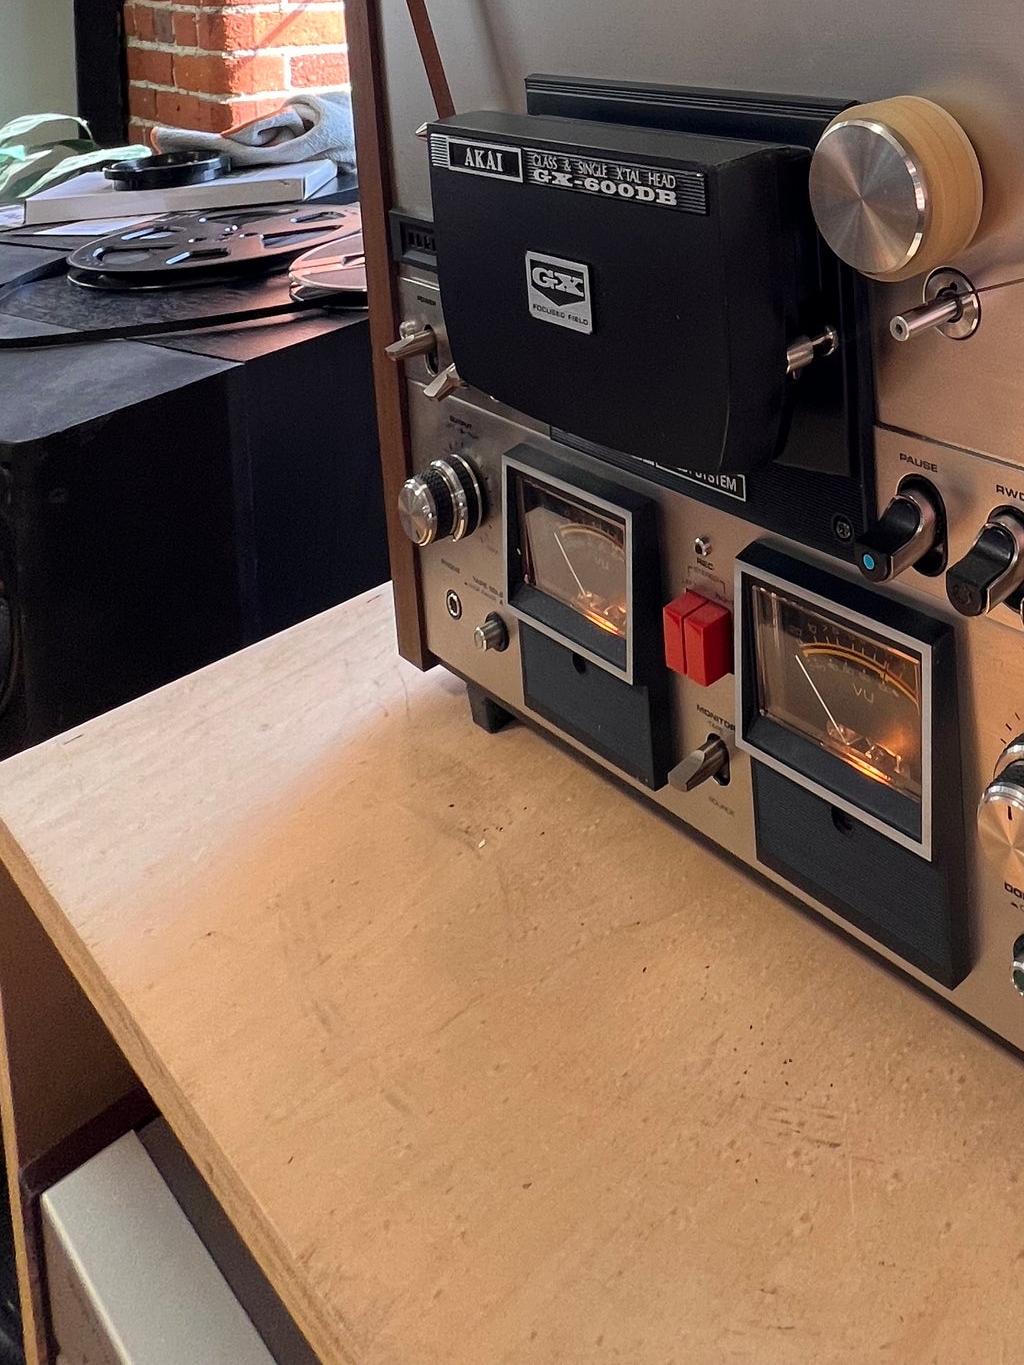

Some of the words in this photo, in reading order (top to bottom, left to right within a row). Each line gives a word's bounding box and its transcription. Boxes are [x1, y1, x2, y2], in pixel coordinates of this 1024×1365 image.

[464, 147, 503, 172] AKAI
[563, 158, 572, 172] &
[577, 160, 609, 179] SINGLE
[615, 166, 642, 184] X'TAL
[648, 172, 676, 189] HEAD
[533, 169, 678, 207] GX-600DB
[531, 266, 585, 298] GX
[532, 303, 565, 320] FOCUSED
[567, 314, 589, 326] FIELD
[899, 452, 938, 473] PAUSE
[852, 681, 874, 704] VU
[696, 703, 736, 731] MONITOR
